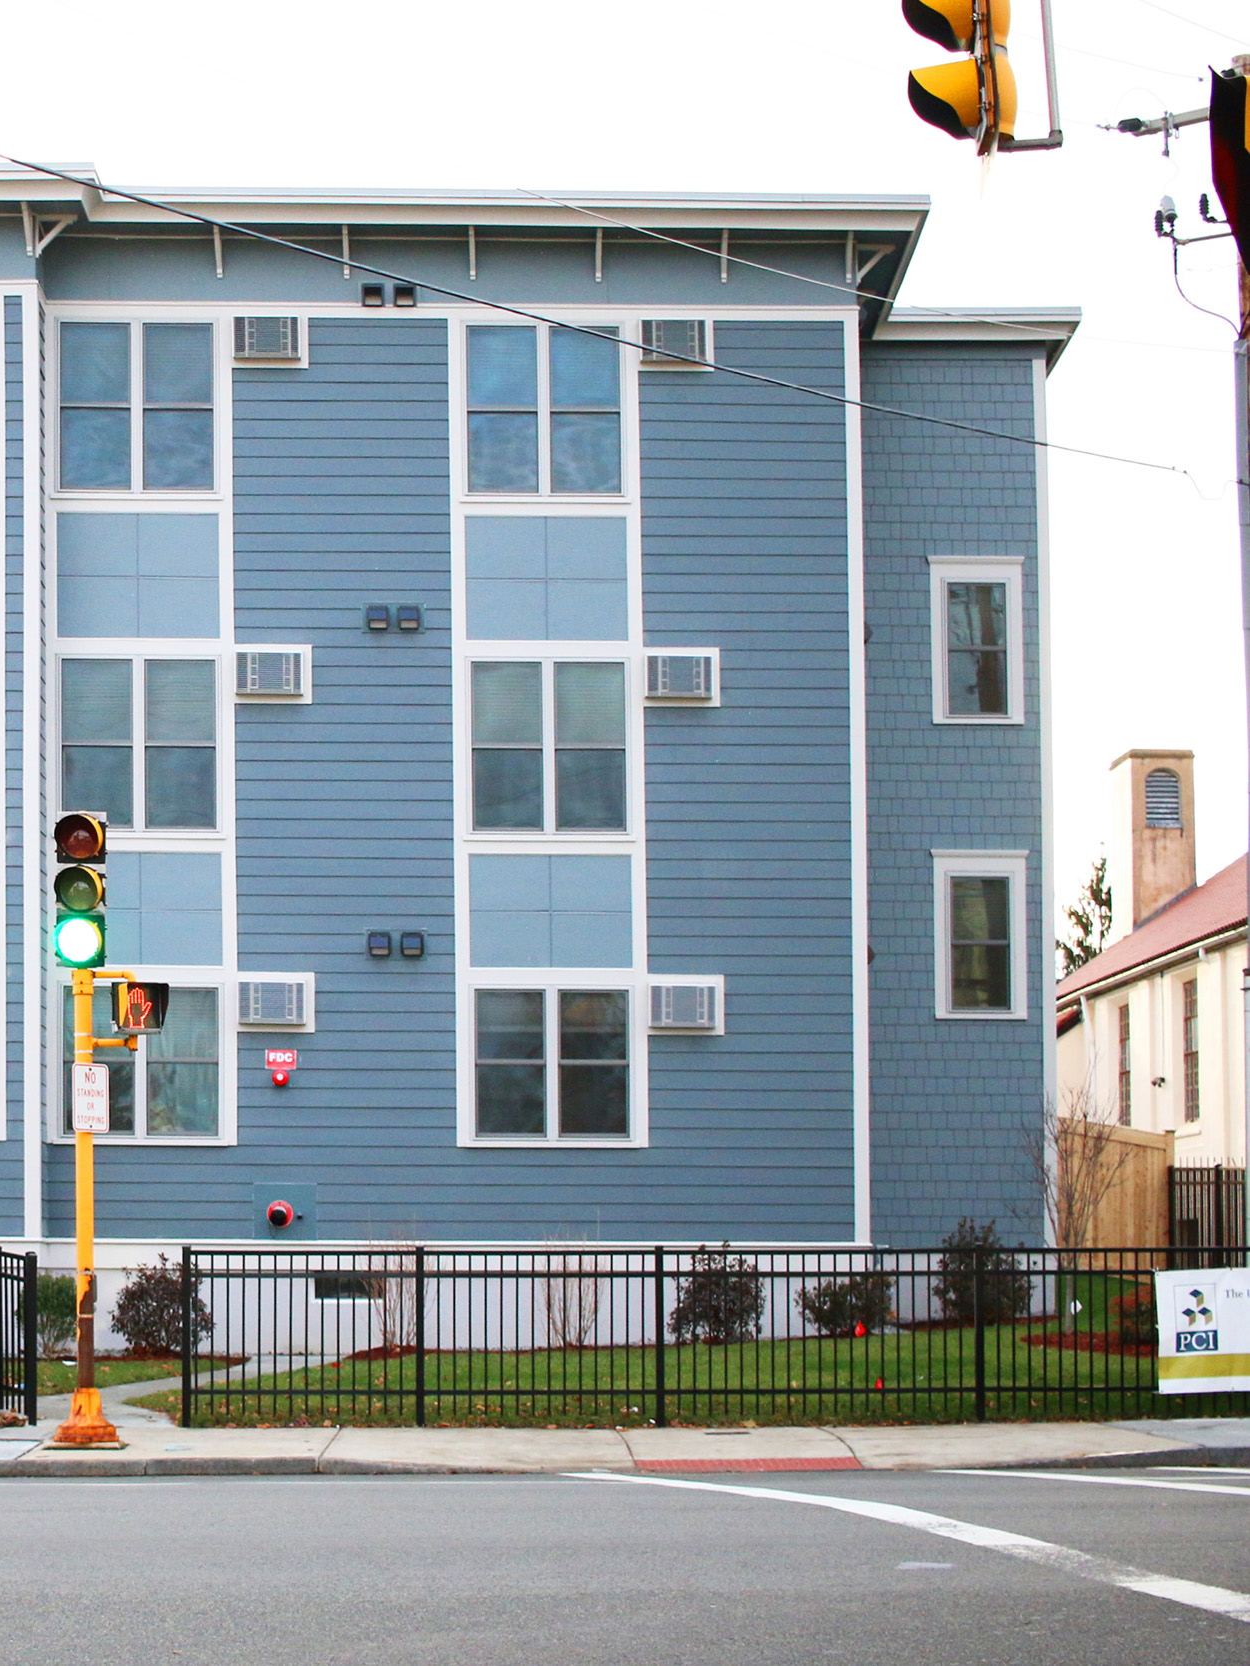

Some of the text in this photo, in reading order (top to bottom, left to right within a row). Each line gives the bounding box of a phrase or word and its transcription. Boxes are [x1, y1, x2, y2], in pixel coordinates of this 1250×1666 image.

[268, 1052, 294, 1063] FDC
[84, 1071, 97, 1085] NO
[76, 1087, 105, 1098] STANDING
[86, 1102, 95, 1111] OR
[76, 1114, 105, 1125] STOPPING
[1225, 1288, 1244, 1299] The
[1179, 1331, 1215, 1351] PCI
